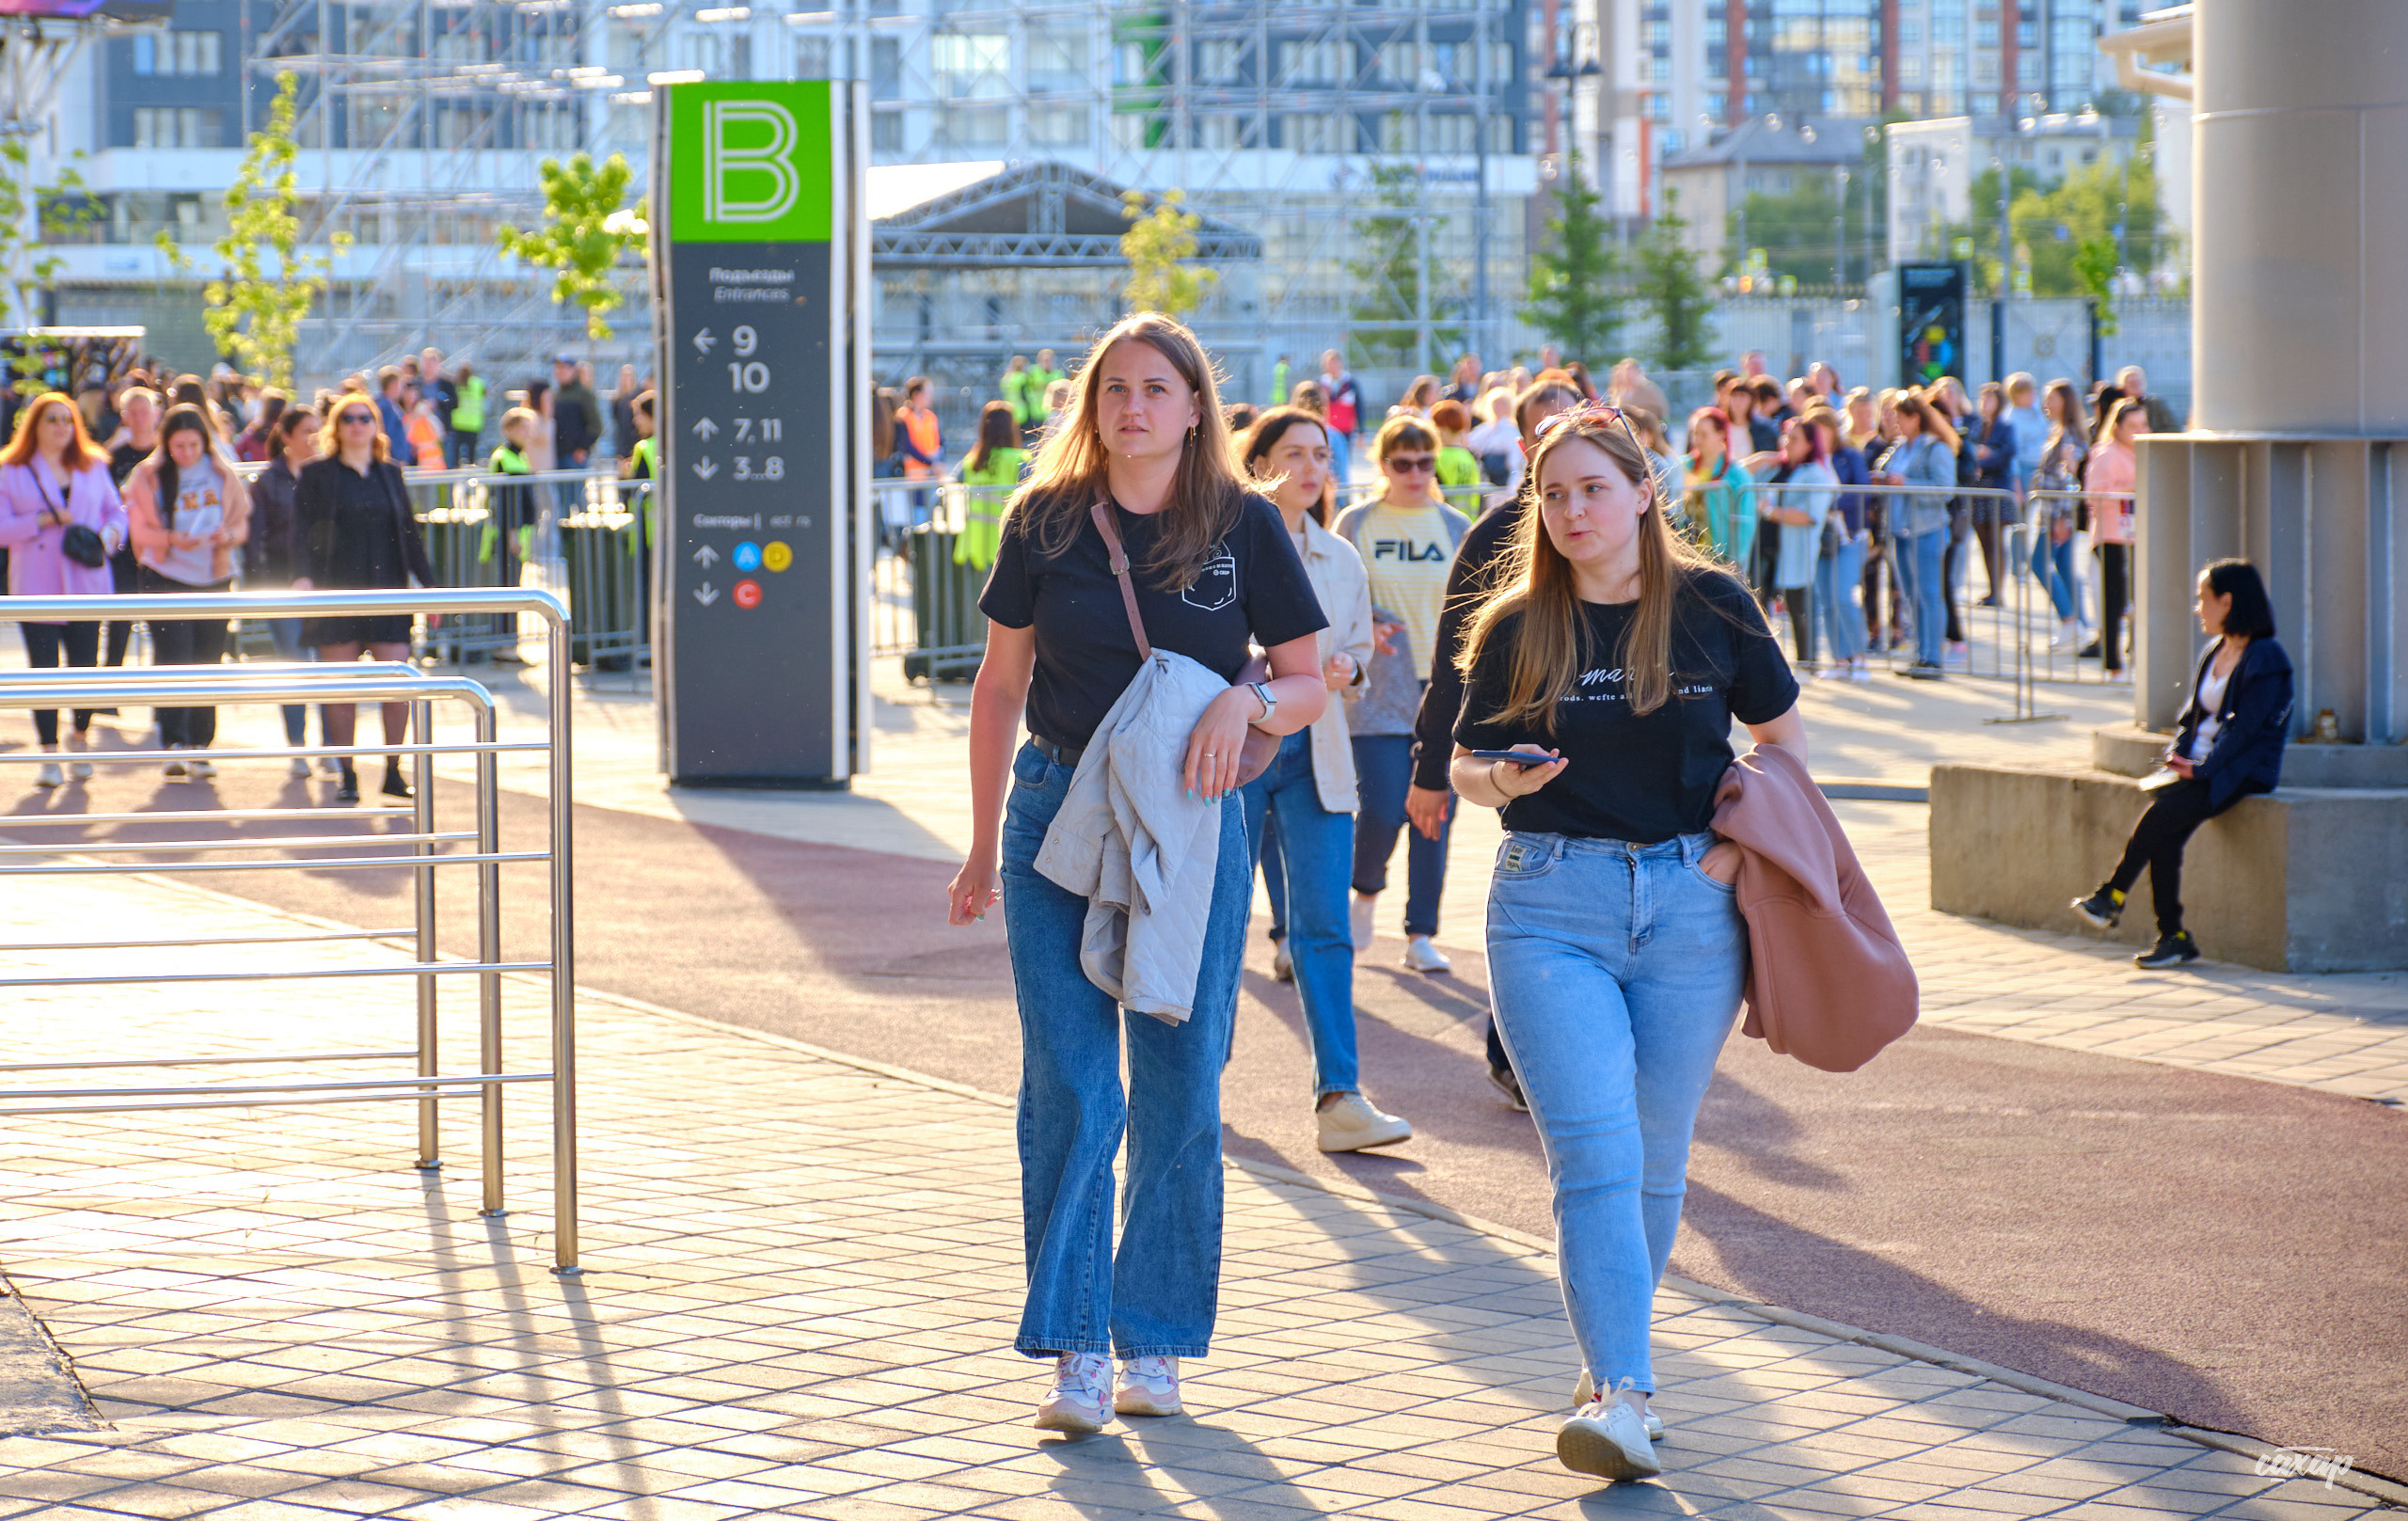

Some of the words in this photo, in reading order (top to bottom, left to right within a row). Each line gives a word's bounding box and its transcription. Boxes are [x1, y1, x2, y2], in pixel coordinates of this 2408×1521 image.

[703, 99, 800, 223] B
[713, 286, 790, 302] Entrances
[731, 325, 758, 357] 9
[727, 360, 771, 393] 10
[737, 545, 757, 565] A
[1374, 539, 1446, 562] FILA
[737, 583, 757, 605] C
